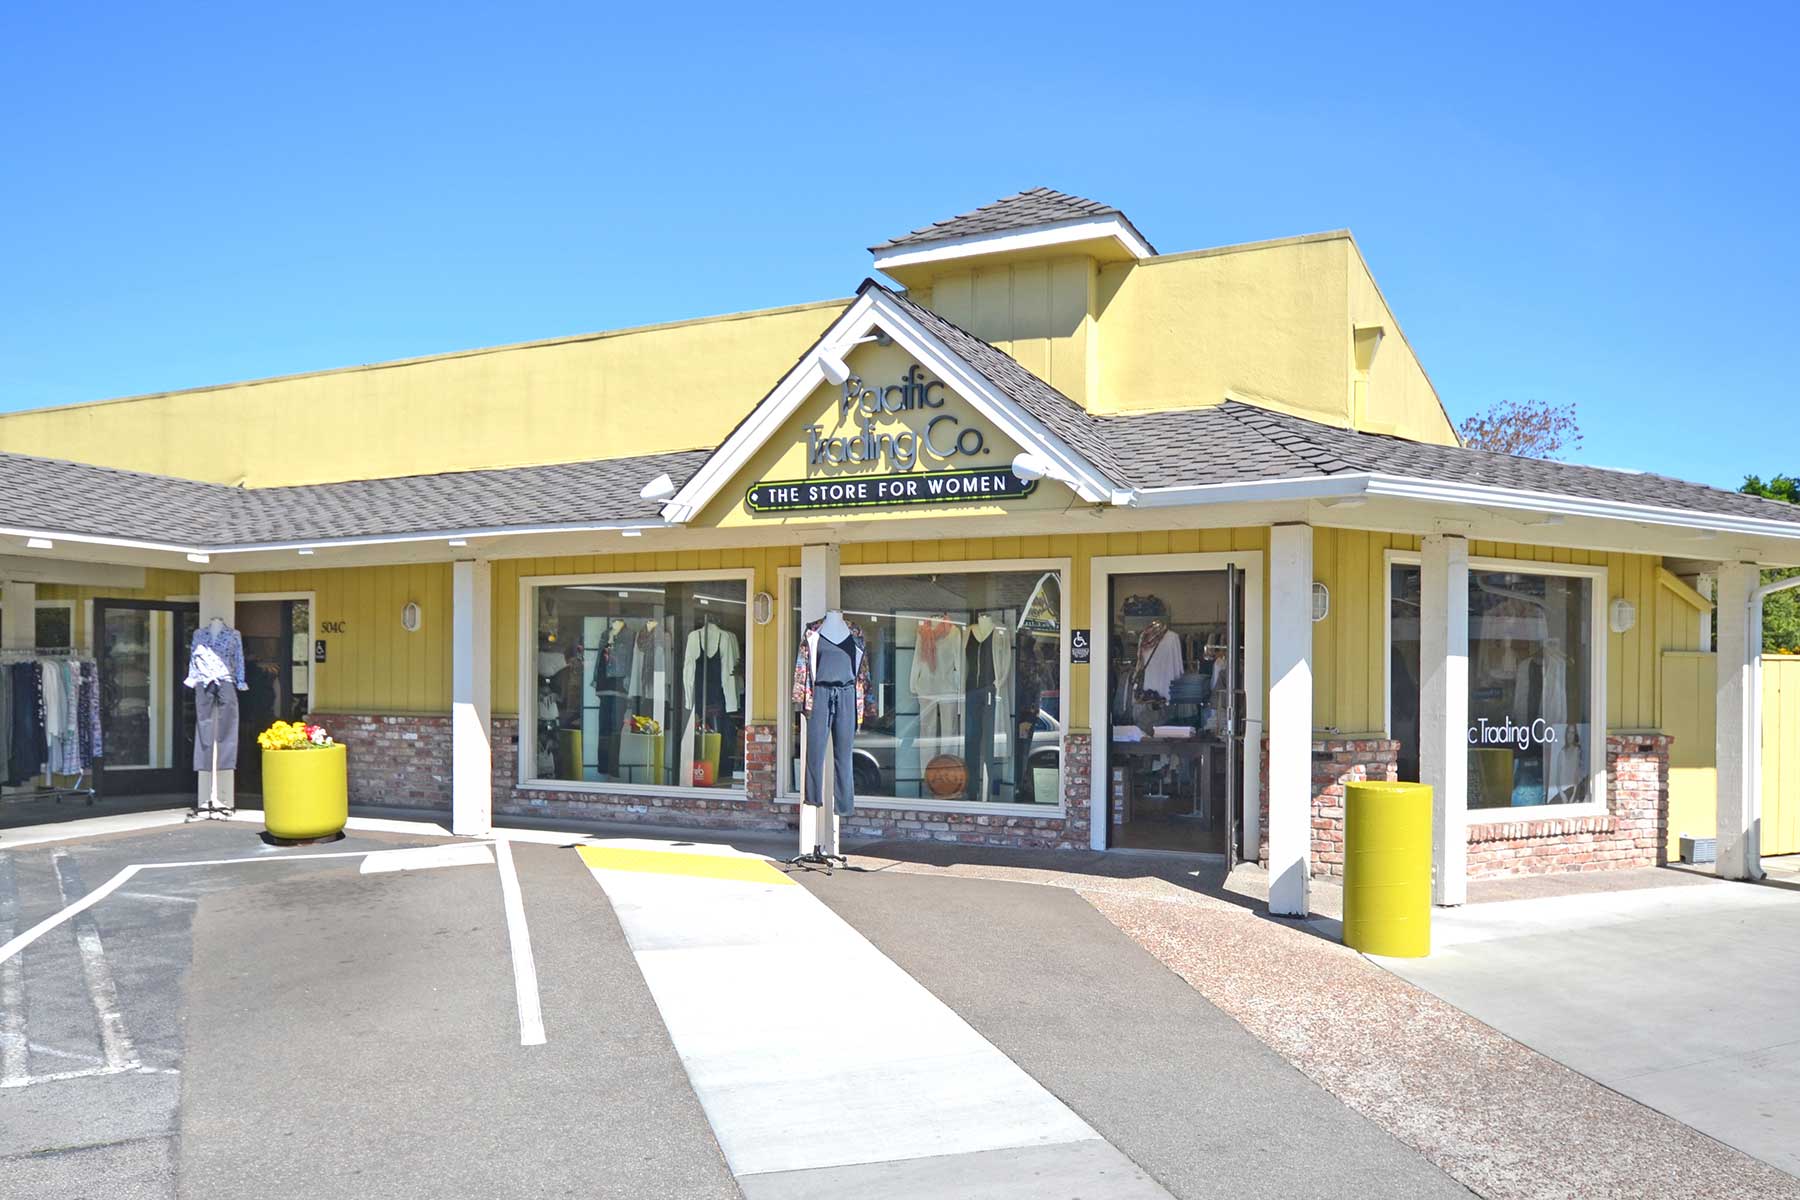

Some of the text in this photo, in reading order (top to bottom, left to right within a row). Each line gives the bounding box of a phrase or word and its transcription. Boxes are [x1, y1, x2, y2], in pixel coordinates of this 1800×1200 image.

[841, 364, 945, 417] Pacific
[802, 414, 990, 470] Trading Co.
[768, 475, 1007, 503] THE STORE FOR WOMEN
[1477, 715, 1530, 750] Trading
[1531, 718, 1558, 743] Co.
